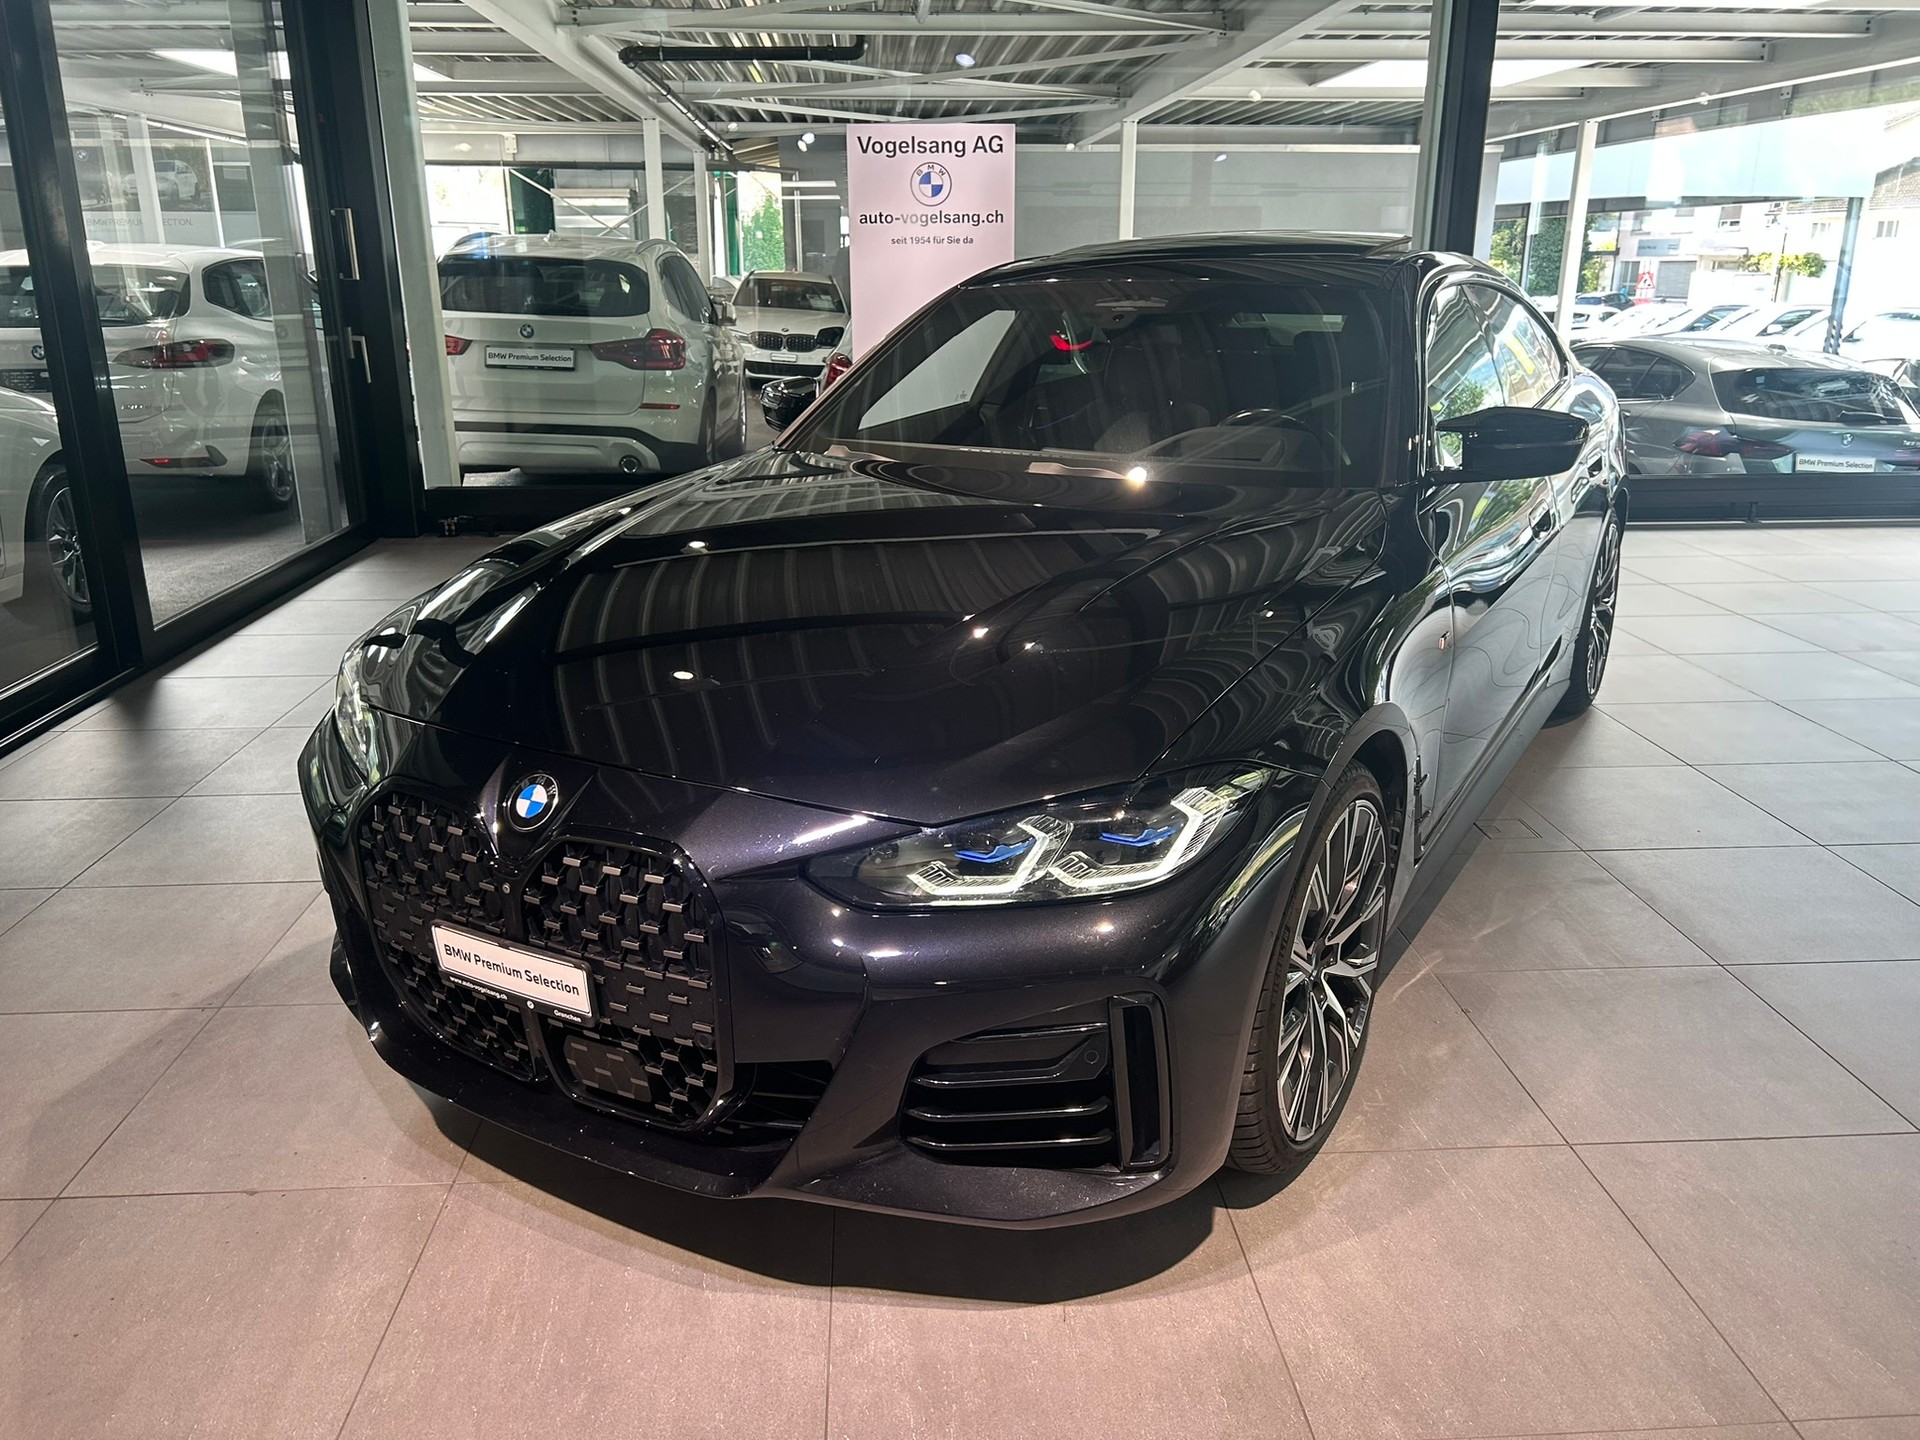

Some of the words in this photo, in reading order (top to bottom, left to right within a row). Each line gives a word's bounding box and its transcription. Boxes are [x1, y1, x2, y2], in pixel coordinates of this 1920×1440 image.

[857, 135, 966, 158] Vogelsang
[972, 135, 1004, 154] AG
[916, 164, 946, 177] BMW
[108, 218, 143, 226] PREMIU
[163, 218, 193, 226] ECTION.
[859, 210, 1004, 227] auto-vogelsang.ch
[891, 237, 907, 245] seit
[910, 236, 931, 245] 1954
[933, 236, 945, 245] für
[947, 236, 961, 245] Sie
[963, 236, 974, 245] da
[488, 352, 507, 360] BMW
[508, 353, 539, 361] Premium
[540, 354, 572, 362] Selection
[1817, 459, 1845, 467] Premium
[1845, 461, 1873, 469] Selection
[443, 943, 472, 963] BMW
[473, 954, 523, 980] Premium
[524, 969, 580, 996] Selection
[554, 1009, 582, 1023] Grenchen
